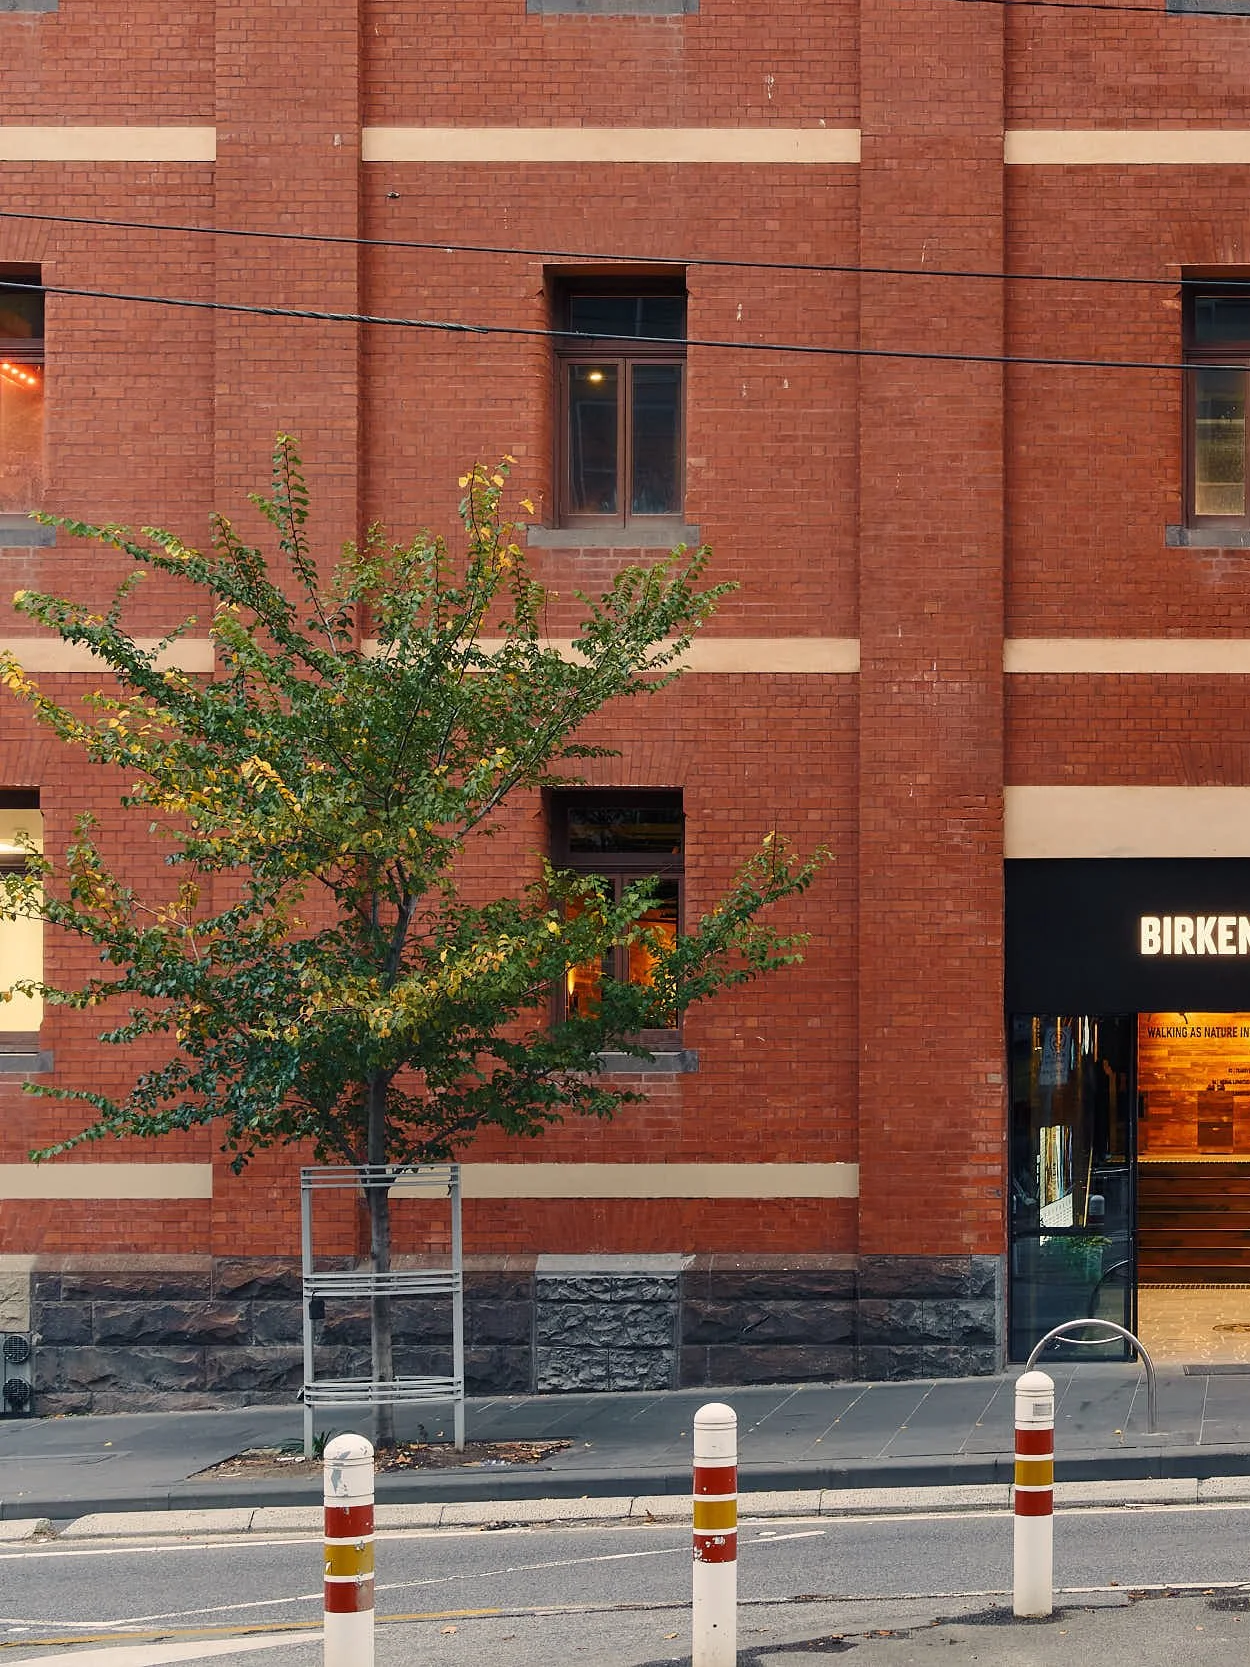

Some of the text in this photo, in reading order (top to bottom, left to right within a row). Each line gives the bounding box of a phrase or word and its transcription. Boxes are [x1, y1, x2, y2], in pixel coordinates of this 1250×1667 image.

[1147, 1026, 1188, 1038] WALKING
[1190, 1026, 1202, 1038] AS
[1204, 1026, 1238, 1038] NATURE
